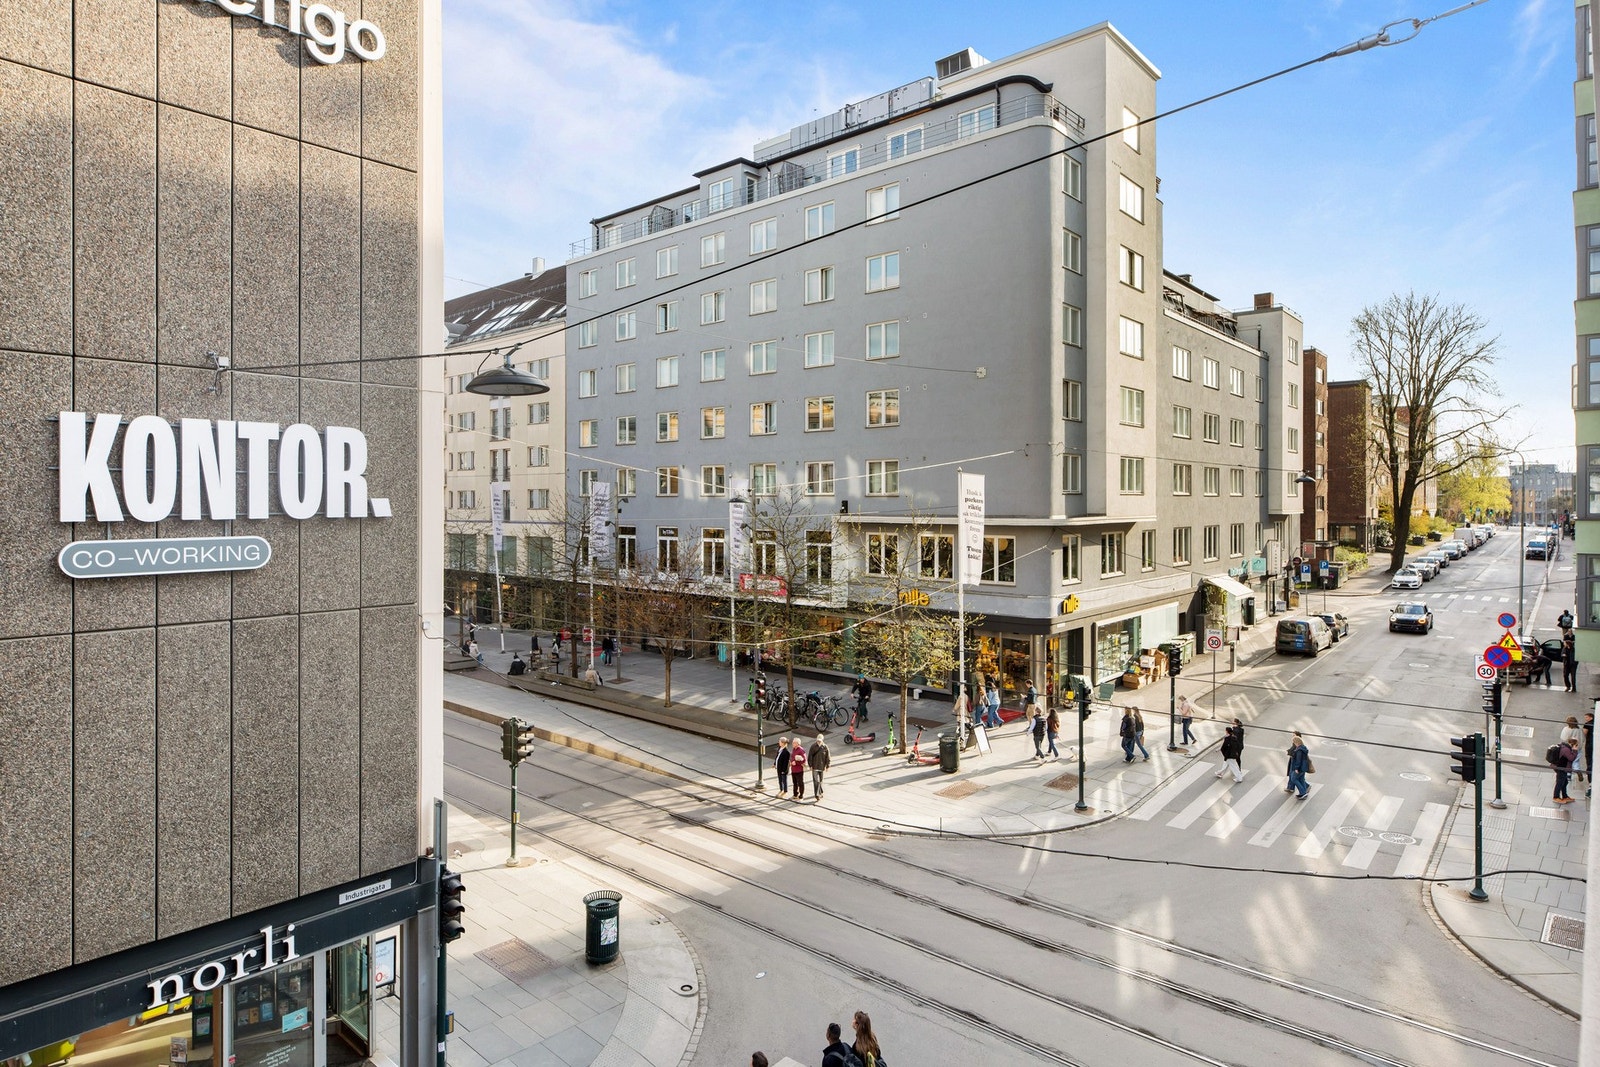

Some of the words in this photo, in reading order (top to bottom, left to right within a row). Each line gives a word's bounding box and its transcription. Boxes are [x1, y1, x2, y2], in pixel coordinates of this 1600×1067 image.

[58, 411, 393, 523] KONTOR.
[71, 544, 261, 569] CO-WORKING
[898, 588, 930, 606] nille
[1481, 667, 1492, 676] 30
[345, 883, 386, 901] Industrigata
[147, 923, 300, 1010] norli
